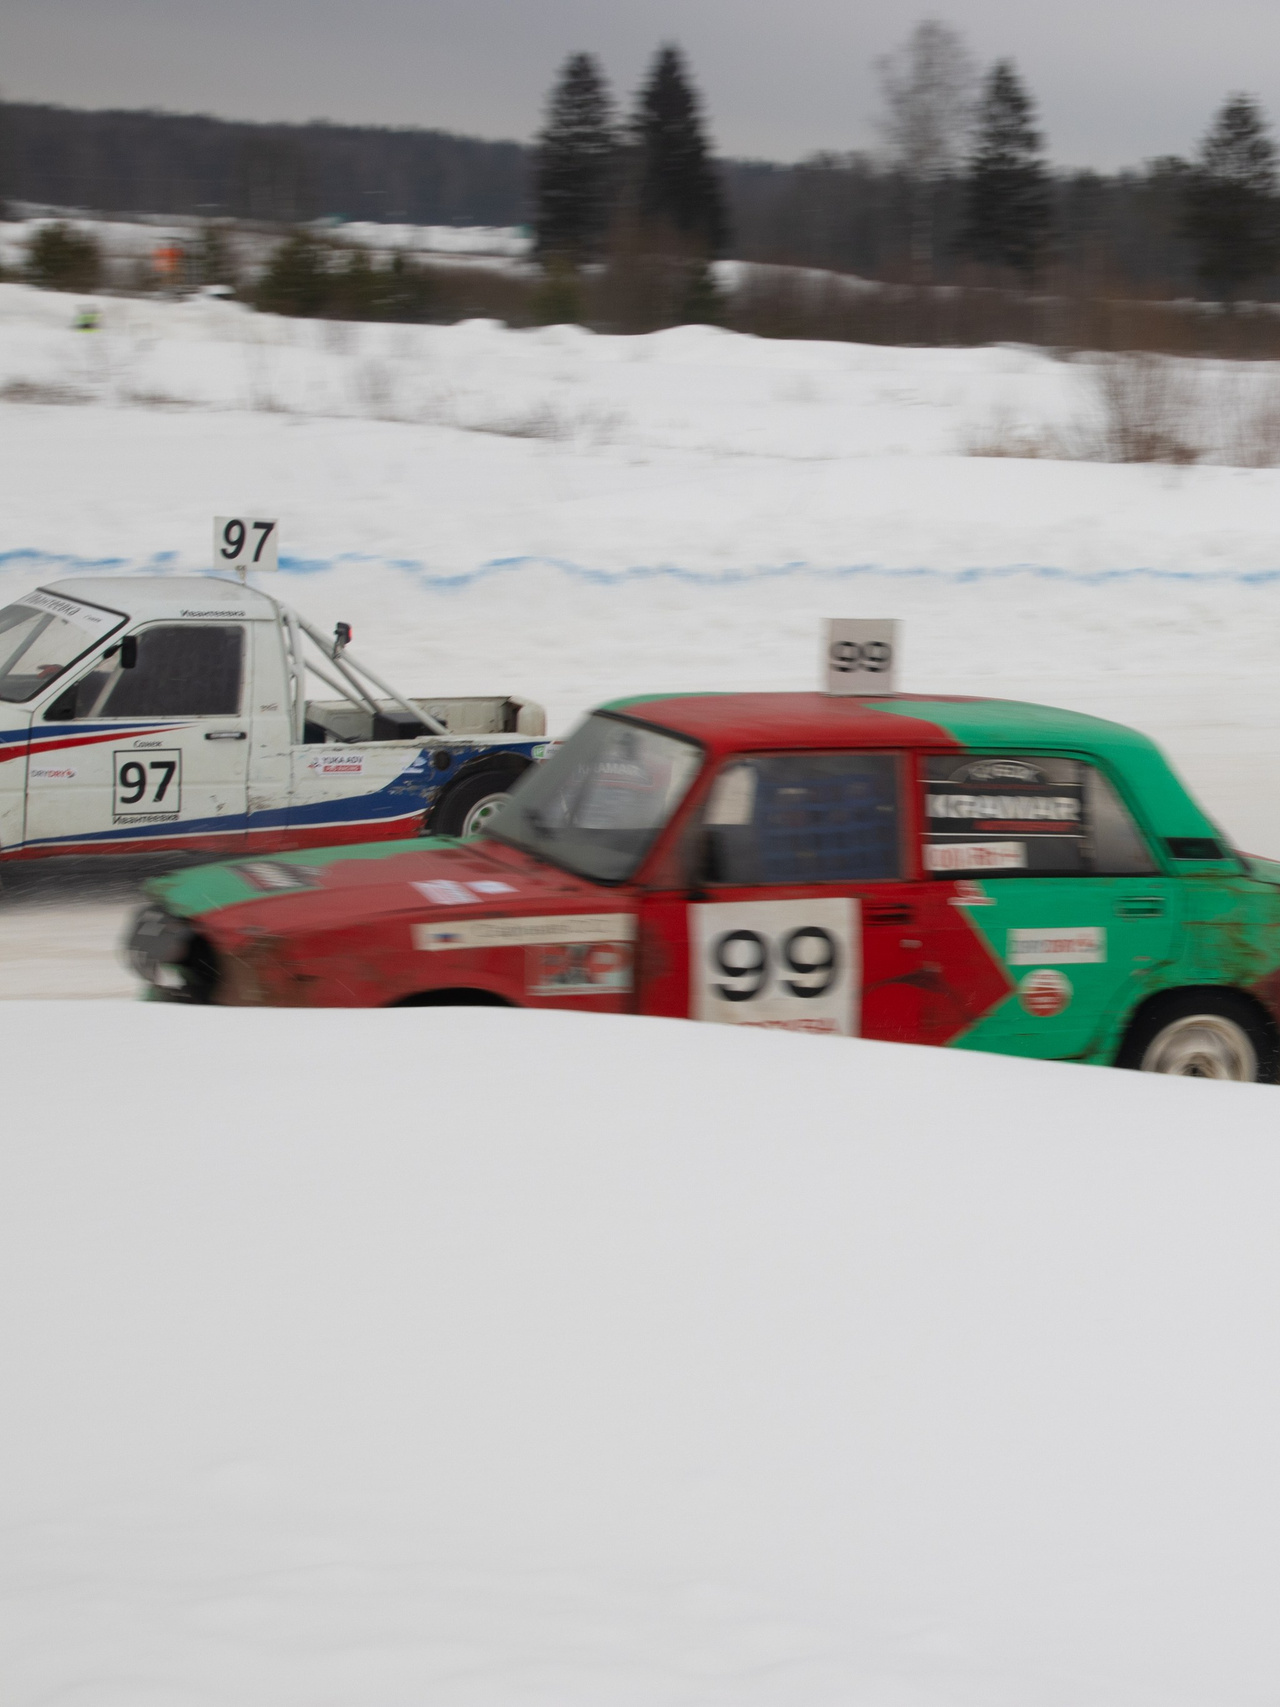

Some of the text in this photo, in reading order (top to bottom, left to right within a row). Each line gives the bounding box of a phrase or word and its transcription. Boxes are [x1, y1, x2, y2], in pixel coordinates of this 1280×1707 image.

[220, 518, 276, 562] 97
[828, 640, 893, 673] 99
[119, 761, 176, 804] 97
[708, 926, 842, 1002] 99
